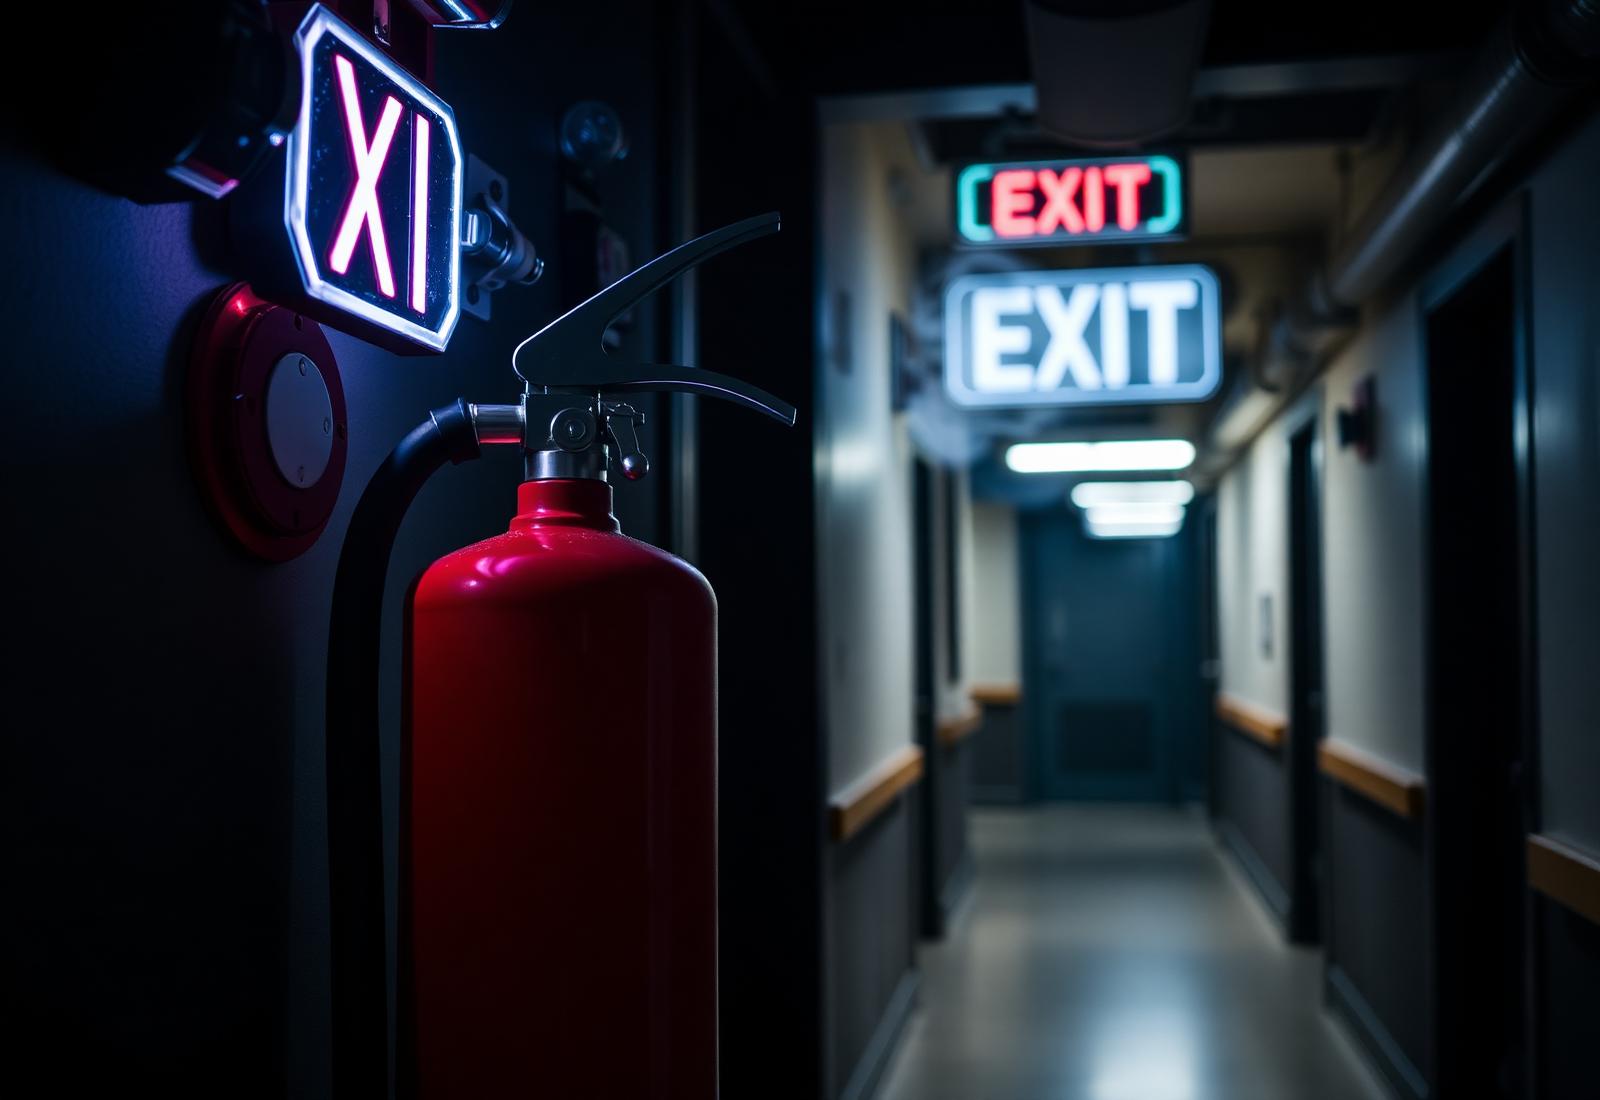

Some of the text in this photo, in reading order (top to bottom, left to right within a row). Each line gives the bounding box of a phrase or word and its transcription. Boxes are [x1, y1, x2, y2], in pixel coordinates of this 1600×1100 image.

[328, 54, 430, 314] XI
[991, 164, 1152, 237] EXIT
[972, 280, 1199, 392] EXIT
